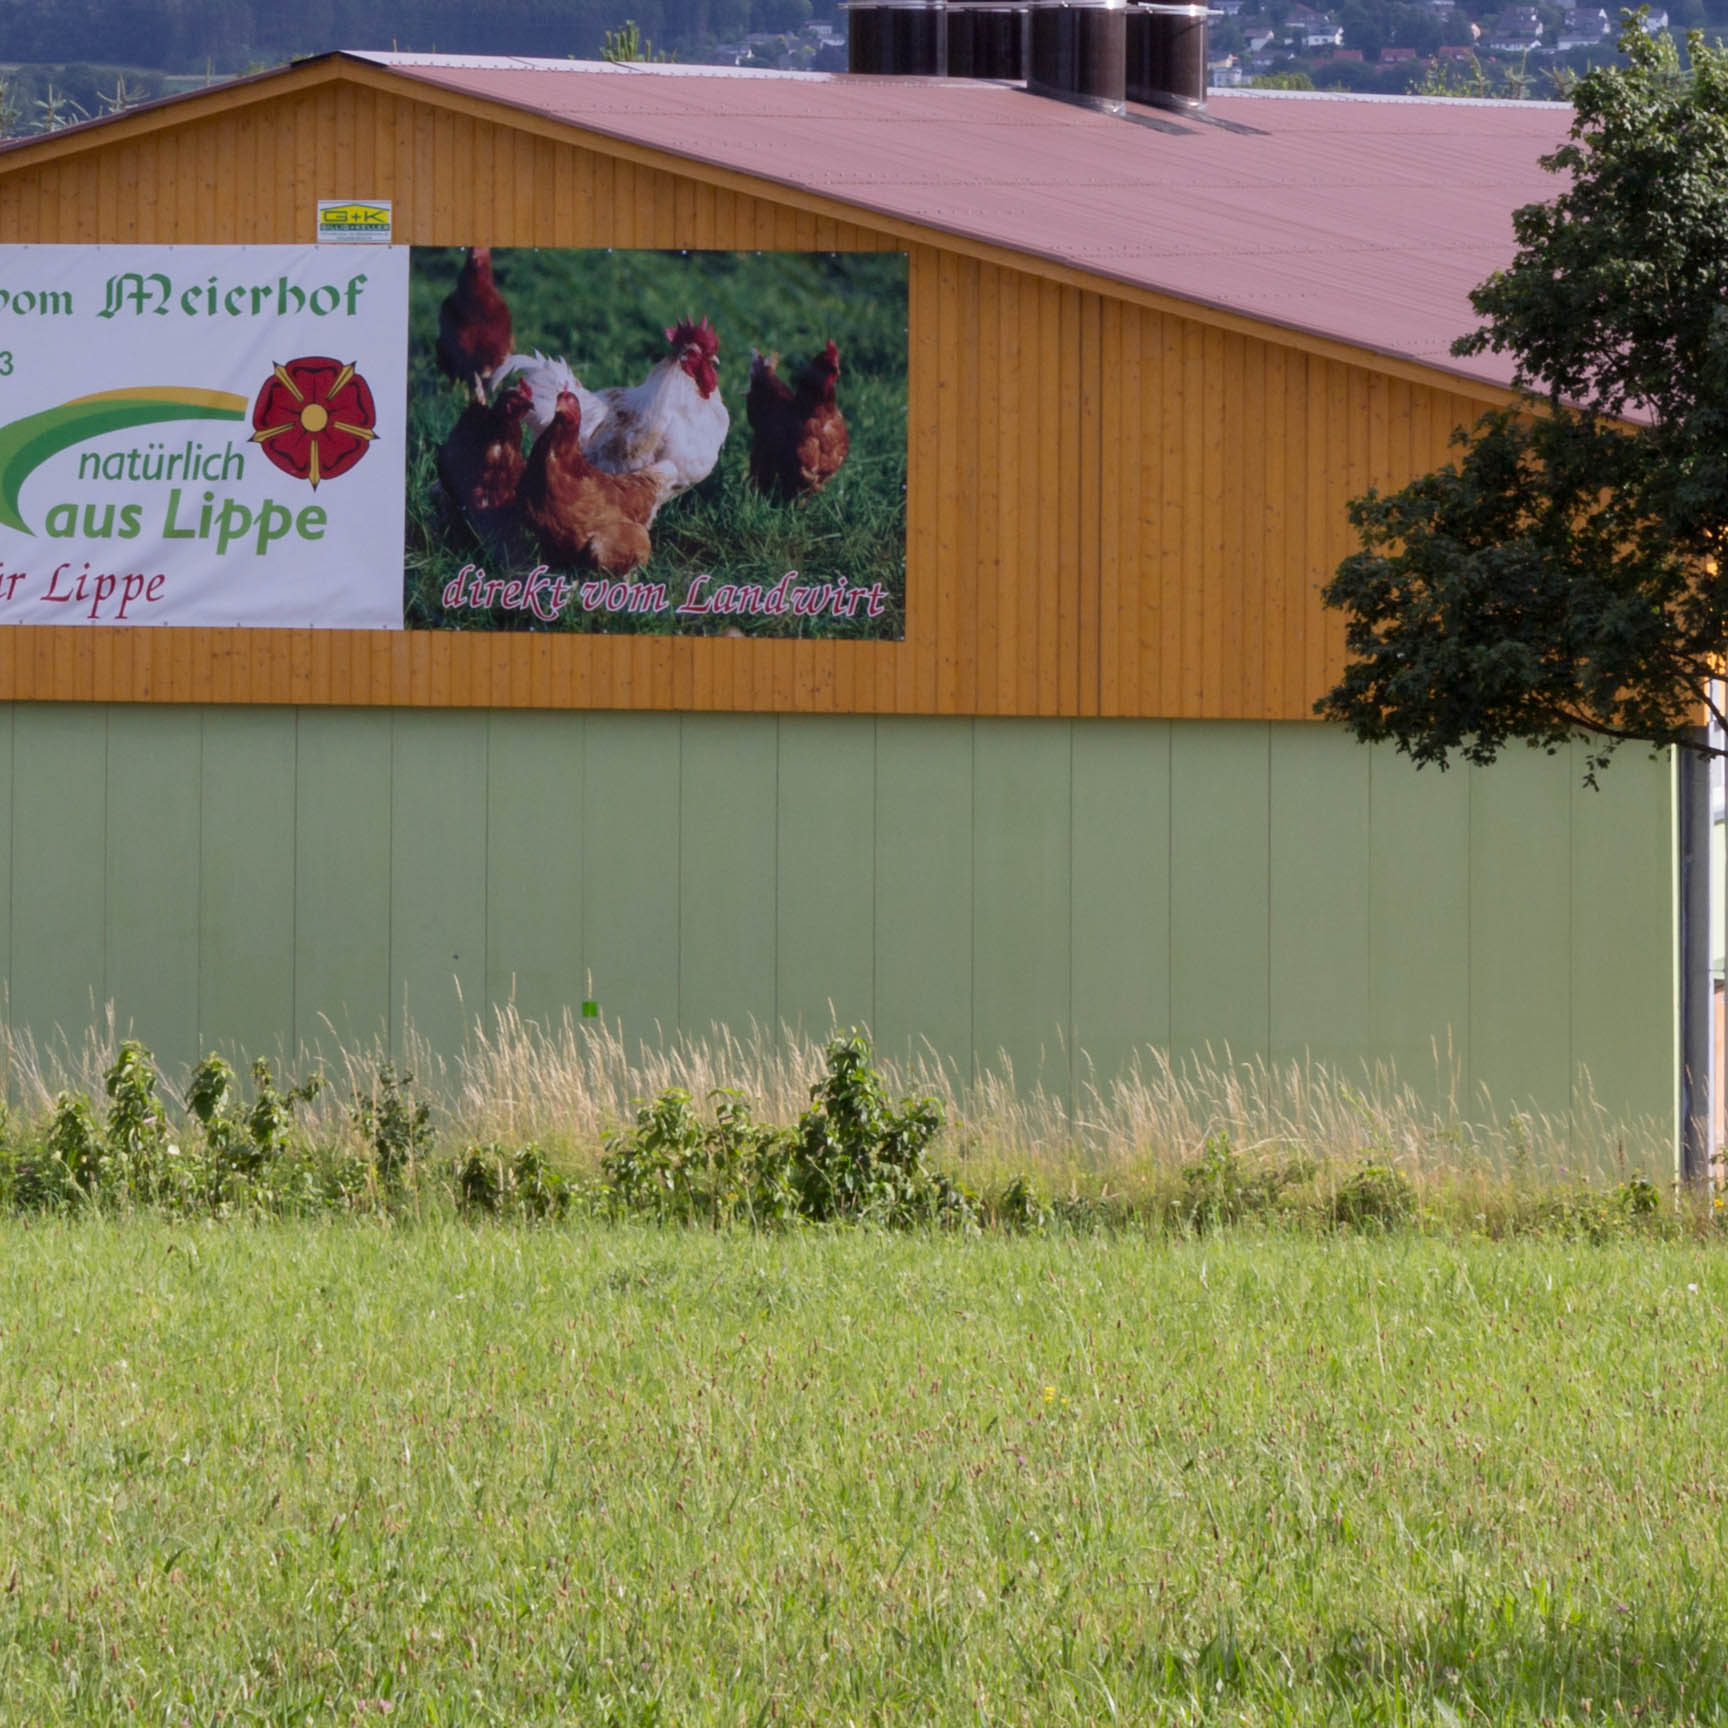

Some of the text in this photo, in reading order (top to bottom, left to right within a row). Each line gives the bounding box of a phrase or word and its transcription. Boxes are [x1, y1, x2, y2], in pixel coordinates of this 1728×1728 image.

[97, 272, 369, 318] Meierhof
[78, 441, 245, 481] natürlich
[45, 488, 327, 555] aus Lippe
[40, 562, 165, 619] Lippe
[441, 564, 889, 622] direkt vom Landwirt
